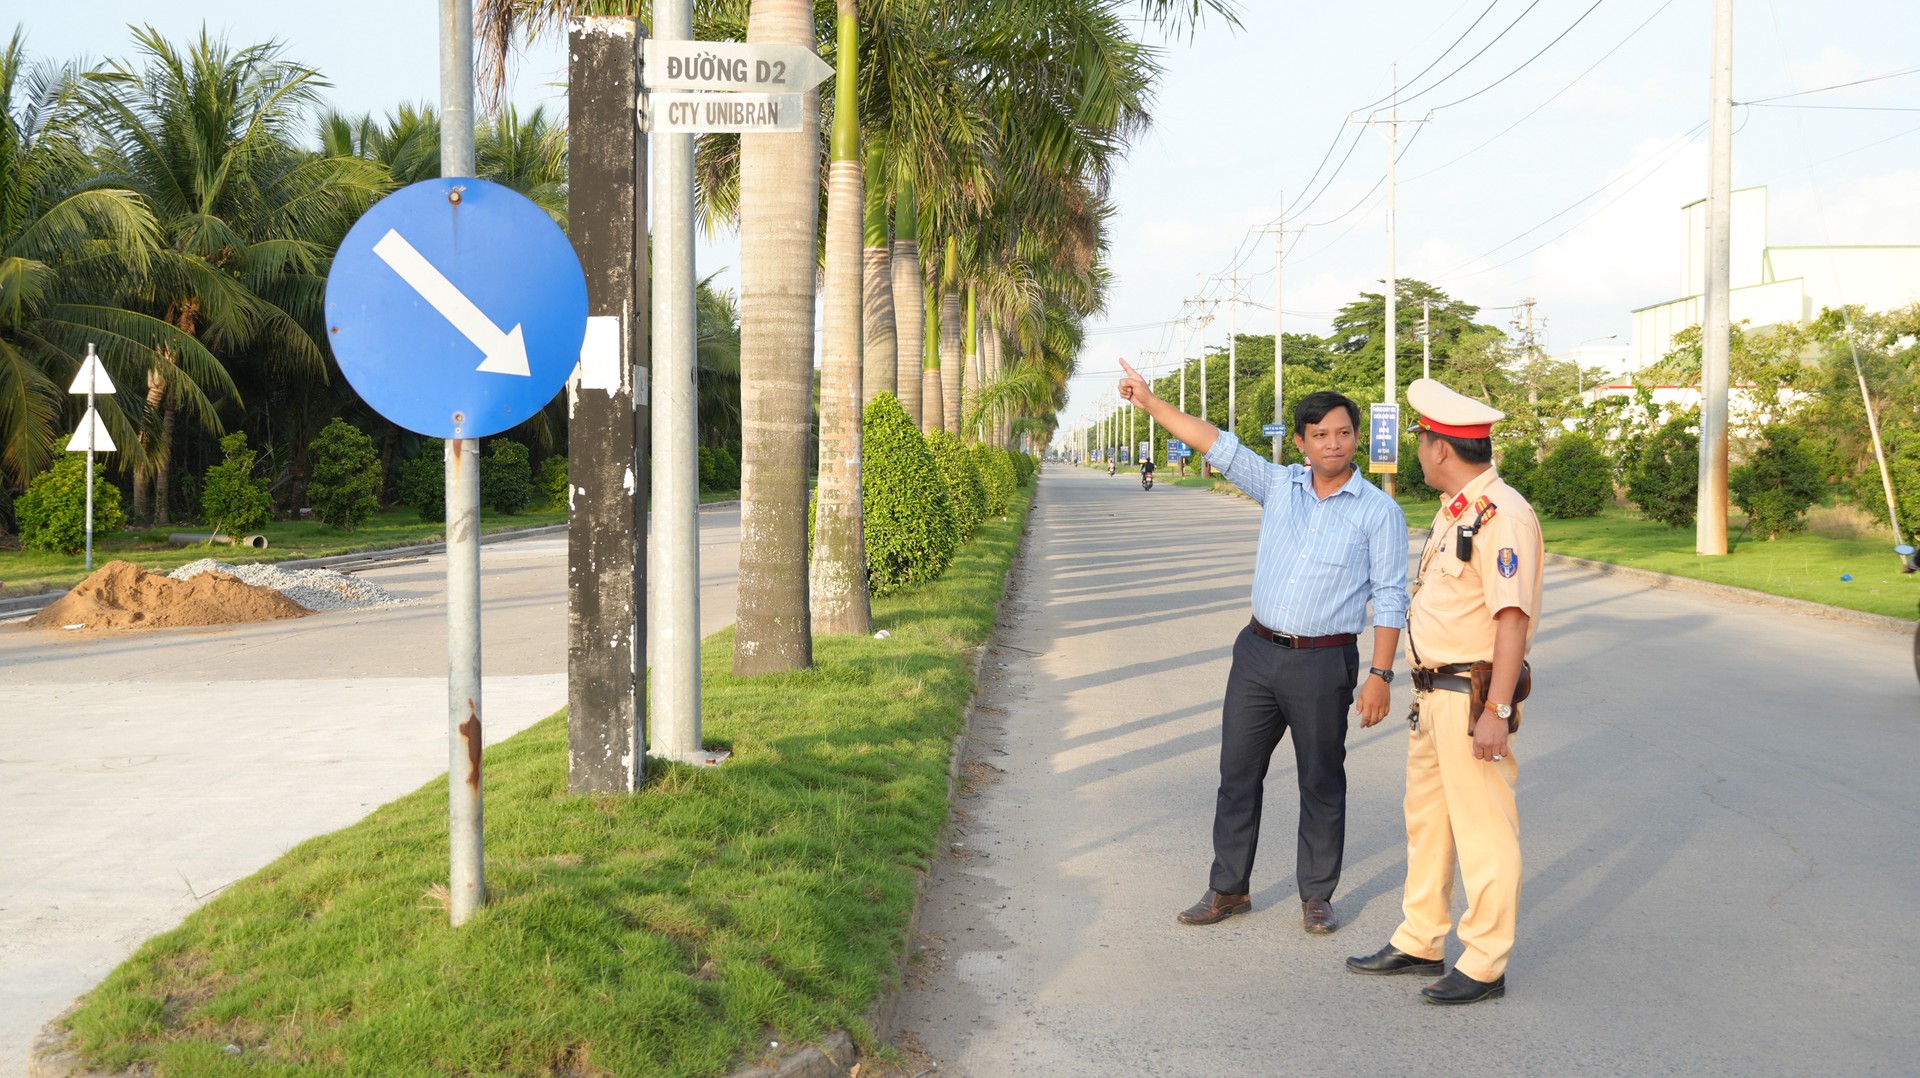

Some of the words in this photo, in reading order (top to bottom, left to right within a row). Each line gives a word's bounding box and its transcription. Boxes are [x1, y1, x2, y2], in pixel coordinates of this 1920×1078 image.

[667, 51, 747, 83] ĐƯỜNG
[756, 60, 786, 84] D2
[668, 102, 700, 125] CTY
[706, 102, 778, 125] UNIBRAN
